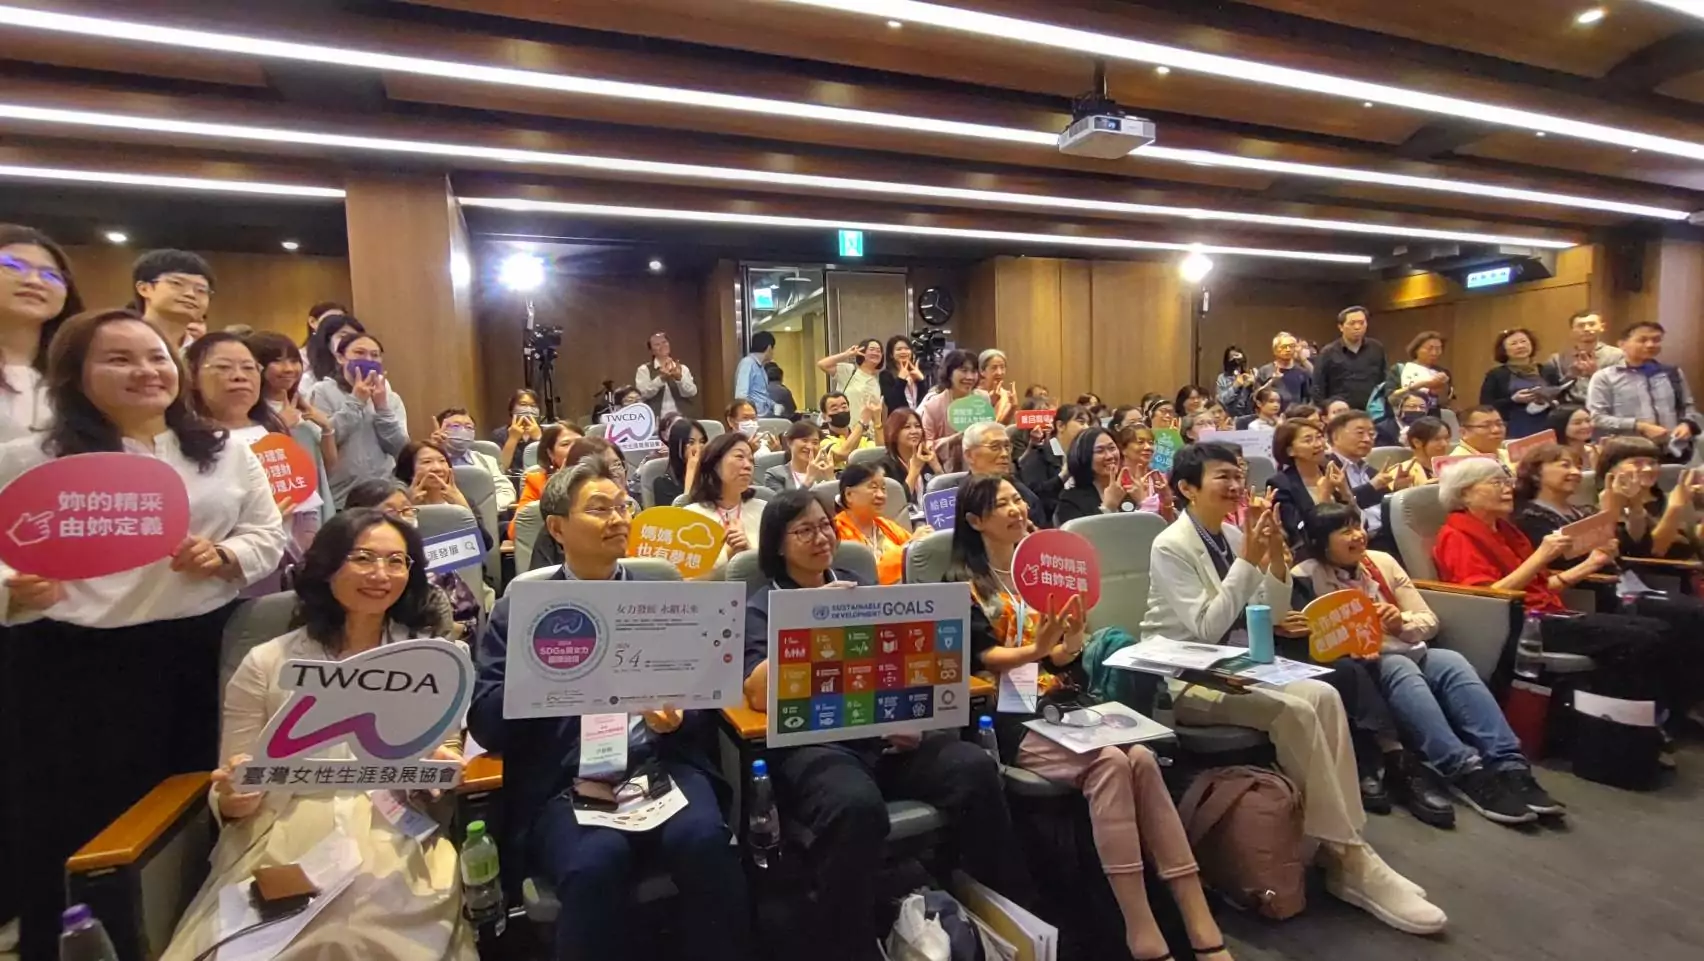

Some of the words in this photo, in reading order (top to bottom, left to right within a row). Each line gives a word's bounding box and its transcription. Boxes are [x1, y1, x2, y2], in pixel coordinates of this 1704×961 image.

[606, 412, 646, 422] TWCDA
[58, 490, 164, 512] 妳的精采
[59, 517, 164, 538] 由妳定義
[641, 523, 673, 545] 媽媽
[1040, 552, 1087, 576] 妳的精采
[1041, 570, 1088, 591] 由妳定義
[831, 602, 880, 611] SUSTAINABLE
[882, 599, 934, 616] GOALS
[831, 610, 880, 619] DEVELOPMENT
[292, 664, 440, 694] TWCDA
[241, 766, 457, 785] 臺灣女性生涯發展協會
